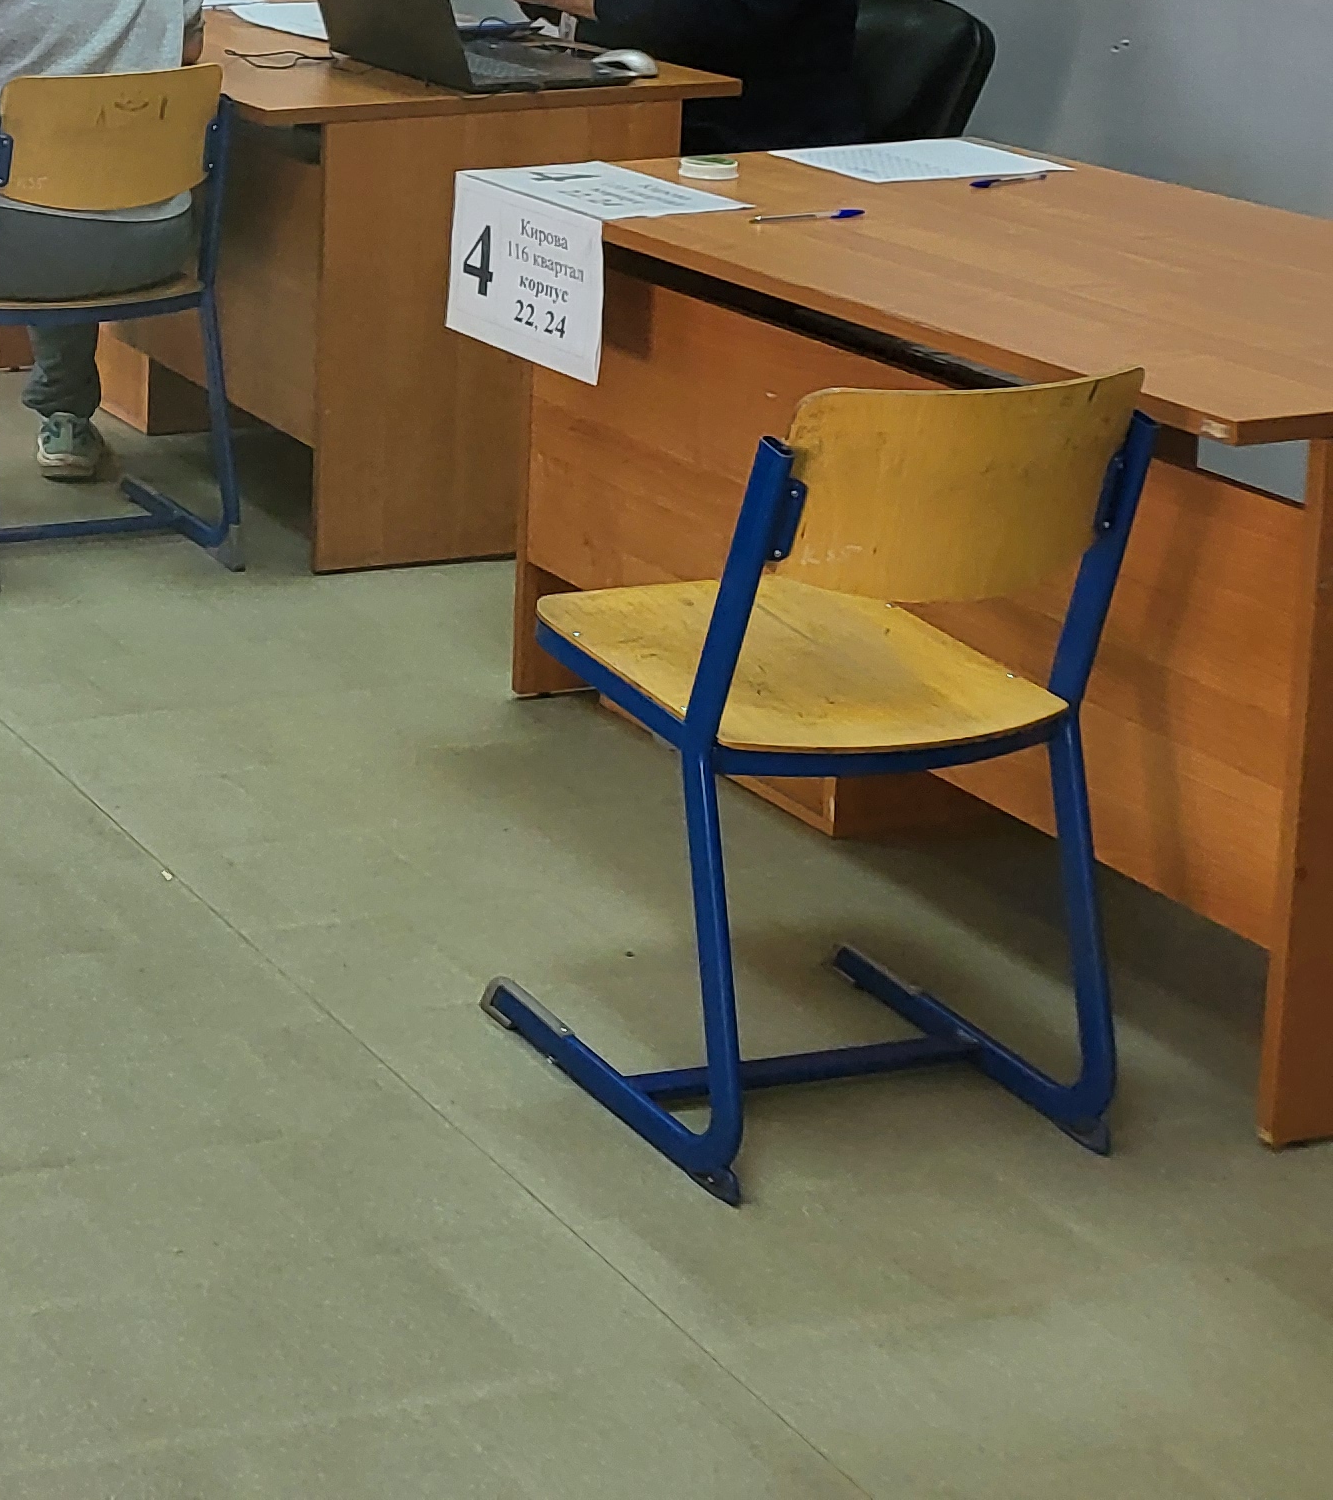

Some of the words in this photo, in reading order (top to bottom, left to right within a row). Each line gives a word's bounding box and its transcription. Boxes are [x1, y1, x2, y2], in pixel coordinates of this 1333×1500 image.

[520, 218, 569, 250] Кирова
[463, 224, 494, 297] 4
[508, 240, 530, 263] 116
[533, 253, 585, 282] квартал
[520, 275, 569, 305] корпус
[543, 310, 567, 339] 24
